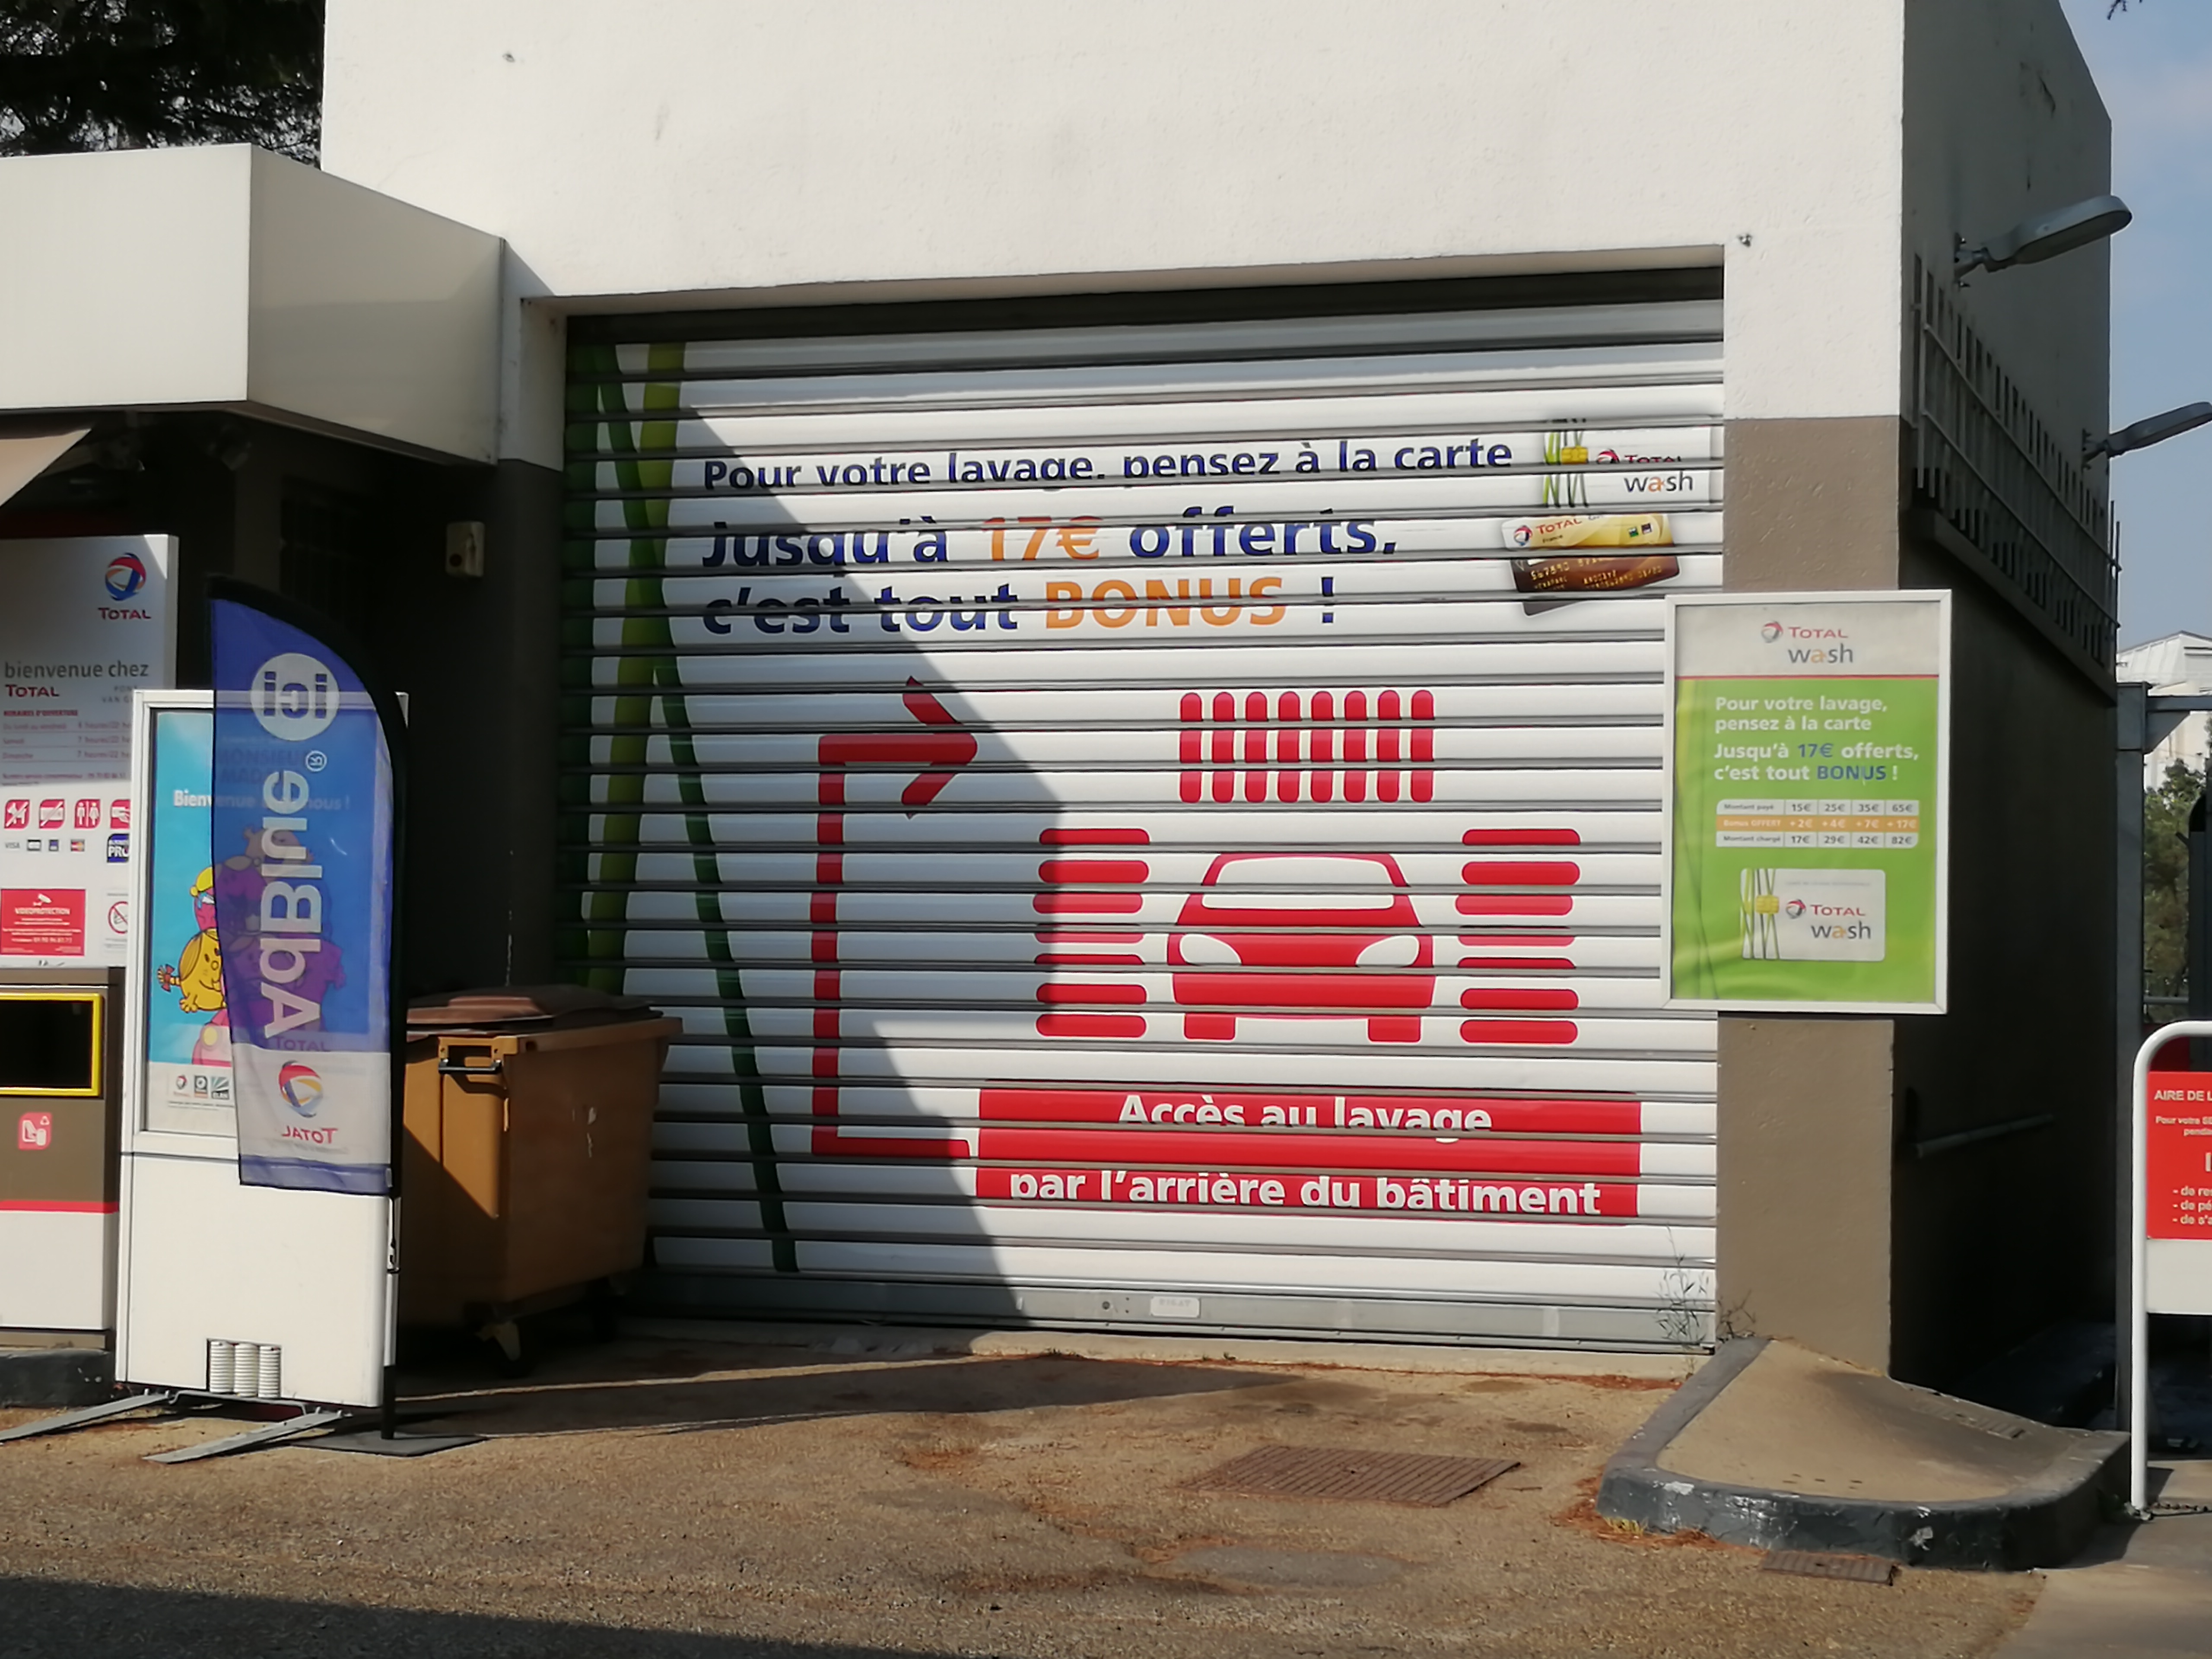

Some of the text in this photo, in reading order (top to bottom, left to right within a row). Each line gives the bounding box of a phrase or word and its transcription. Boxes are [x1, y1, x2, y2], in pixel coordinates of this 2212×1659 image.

[704, 460, 801, 490] Pour
[817, 457, 931, 486] votre
[1124, 451, 1280, 488] pensez
[1296, 442, 1320, 474] à
[1339, 440, 1377, 472] la
[1394, 438, 1513, 470] carte
[1624, 471, 1693, 493] wash
[1535, 518, 1583, 535] TOTAL
[982, 516, 1104, 562] 17€
[703, 576, 1333, 634] c'est tout BONUS !
[98, 607, 152, 621] TOTAL
[1788, 626, 1849, 639] TOTAL
[1788, 643, 1853, 664] wash
[4, 660, 149, 678] bienvenue chez
[5, 683, 60, 698] TOTAL
[1716, 696, 1888, 714] Pour votre lavage,
[1715, 716, 1872, 734] pensez à la carte
[1714, 742, 1920, 764] Jusqu'à 17€ offerts,
[1714, 765, 1897, 781] c'est tout BONUS !
[1791, 804, 1812, 812] 15€
[1824, 804, 1845, 813] 25€
[1859, 804, 1880, 813] 35€
[1892, 804, 1913, 813] 65€
[1723, 819, 1749, 827] Bonus
[1751, 820, 1781, 828] OFFERT
[1791, 836, 1810, 844] 17€
[1824, 836, 1845, 844] 29€
[1858, 836, 1878, 845] 42€
[1892, 836, 1912, 845] 82€
[1810, 904, 1866, 917] TOTAL
[1811, 920, 1871, 939] wash
[2154, 1090, 2184, 1101] AIRE
[2187, 1090, 2205, 1101] DE
[1118, 1094, 1492, 1143] Accès au lavage
[2155, 1116, 2177, 1125] Pour
[1011, 1170, 1601, 1215] par l'arrière du bâtiment
[2181, 1185, 2196, 1196] de
[2181, 1200, 2196, 1210] de
[2180, 1214, 2196, 1225] de
